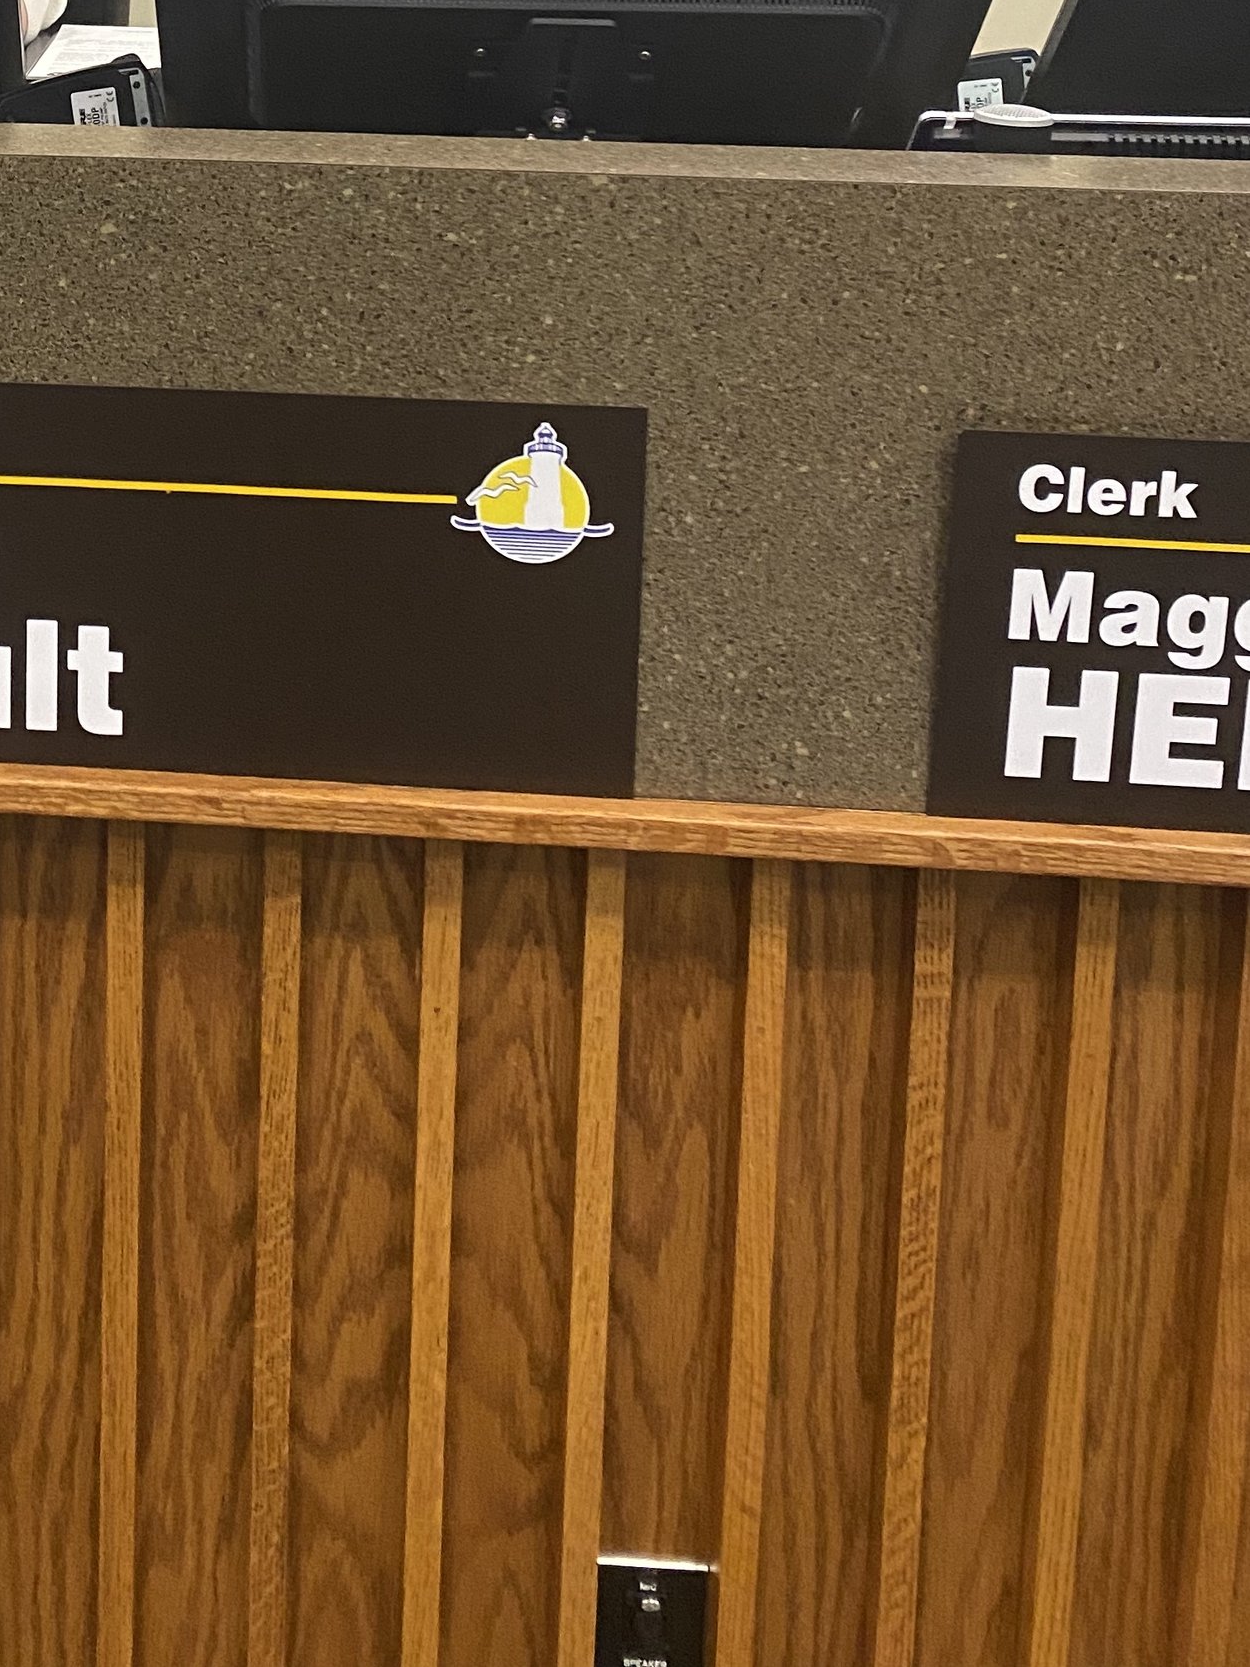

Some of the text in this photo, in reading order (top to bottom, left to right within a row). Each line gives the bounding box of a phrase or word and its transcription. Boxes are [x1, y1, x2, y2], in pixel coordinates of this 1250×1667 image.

[1018, 463, 1199, 519] Clerk
[1007, 568, 1250, 672] Mag
[1004, 665, 1250, 791] HE
